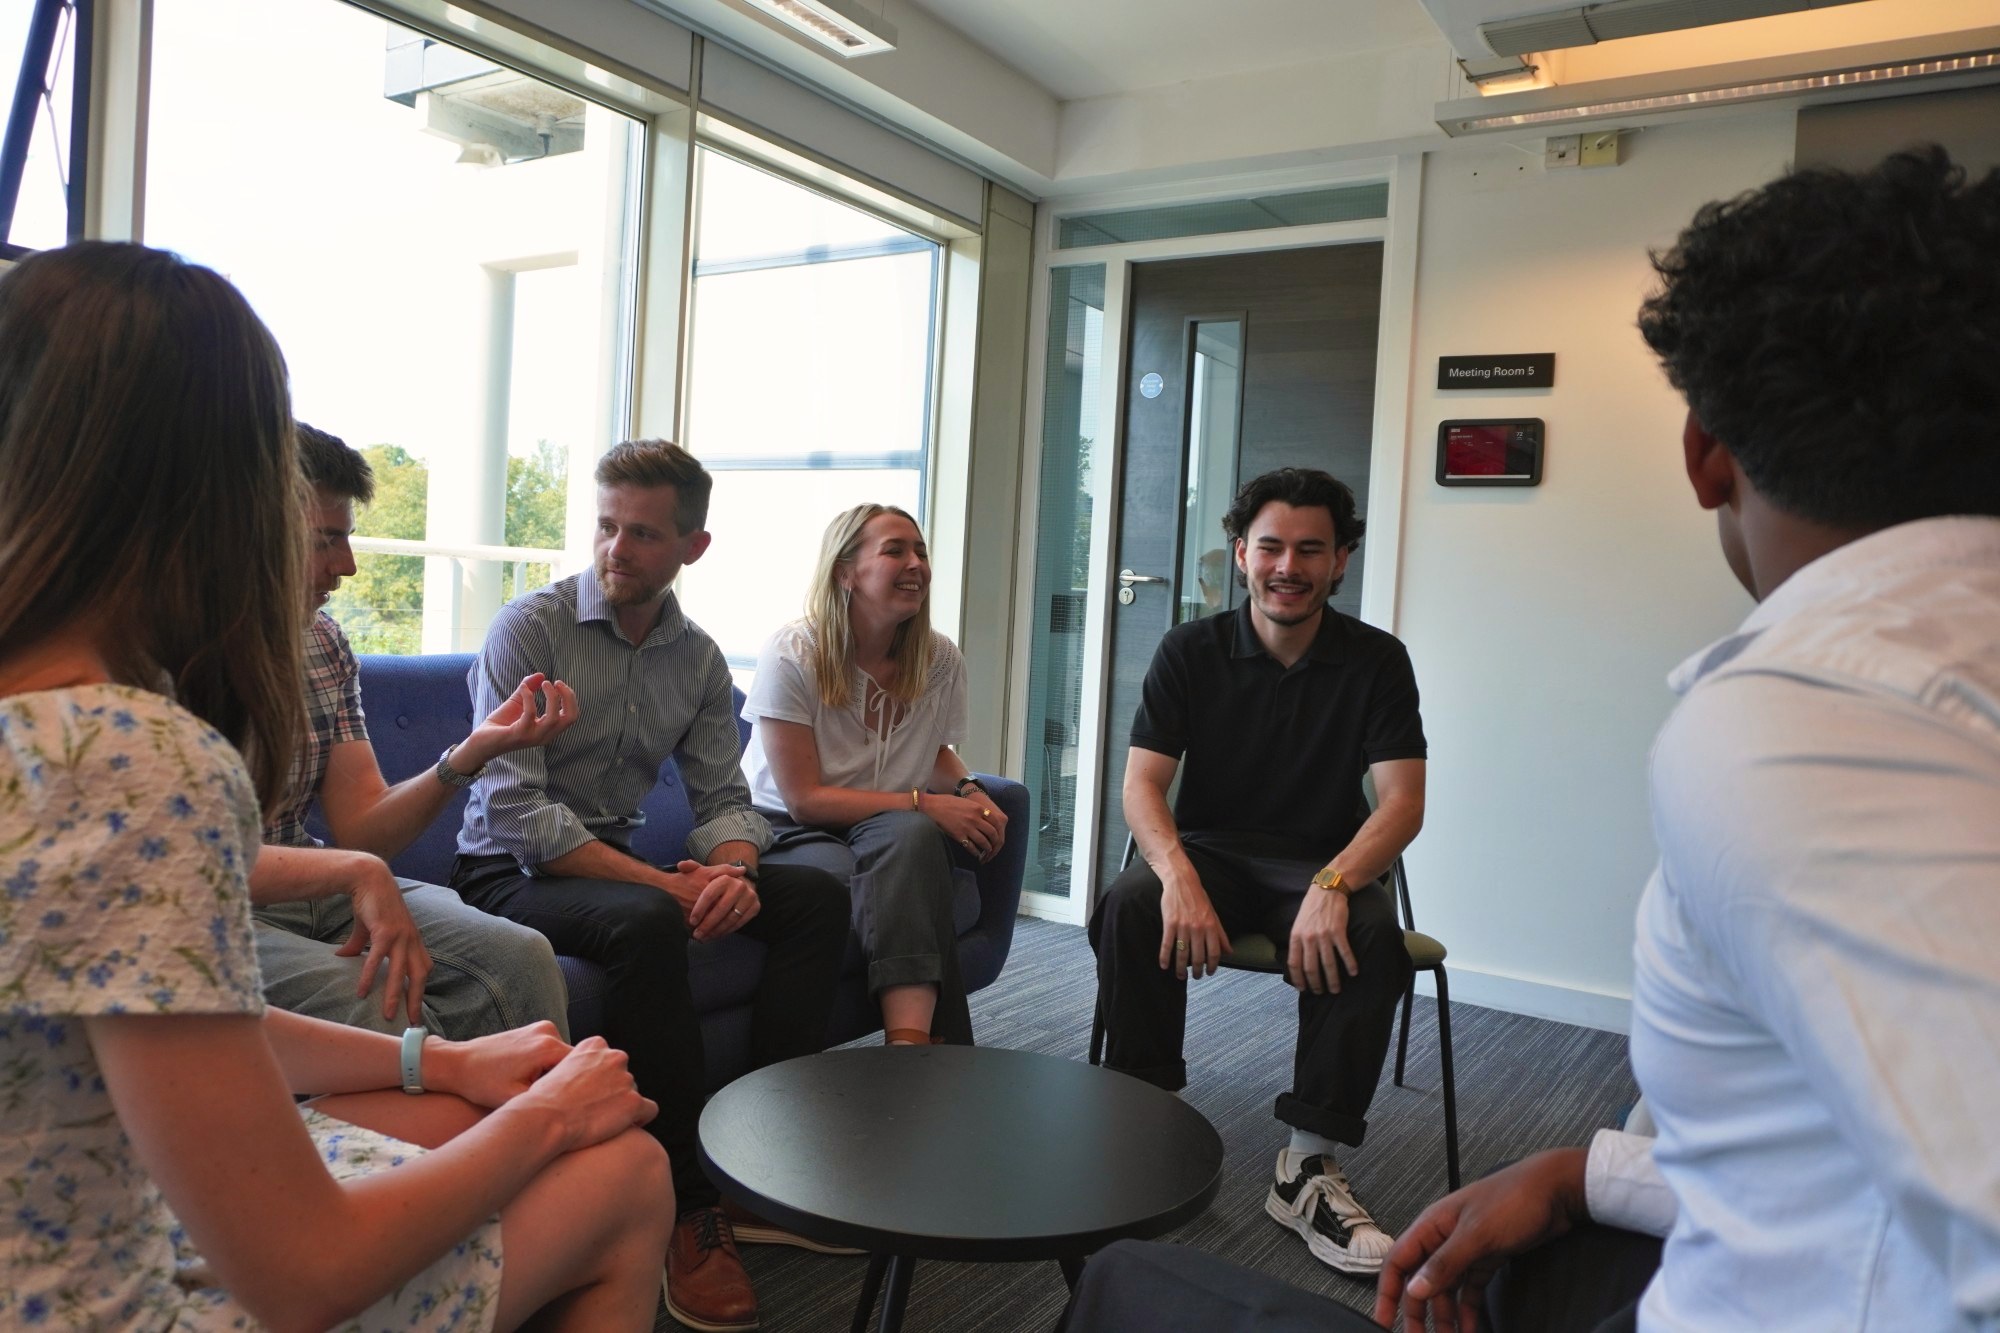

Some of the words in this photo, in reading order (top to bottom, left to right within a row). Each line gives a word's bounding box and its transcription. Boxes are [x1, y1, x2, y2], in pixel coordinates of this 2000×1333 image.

[1449, 368, 1491, 378] Meeting
[1494, 367, 1525, 376] Room
[1528, 366, 1535, 375] 5
